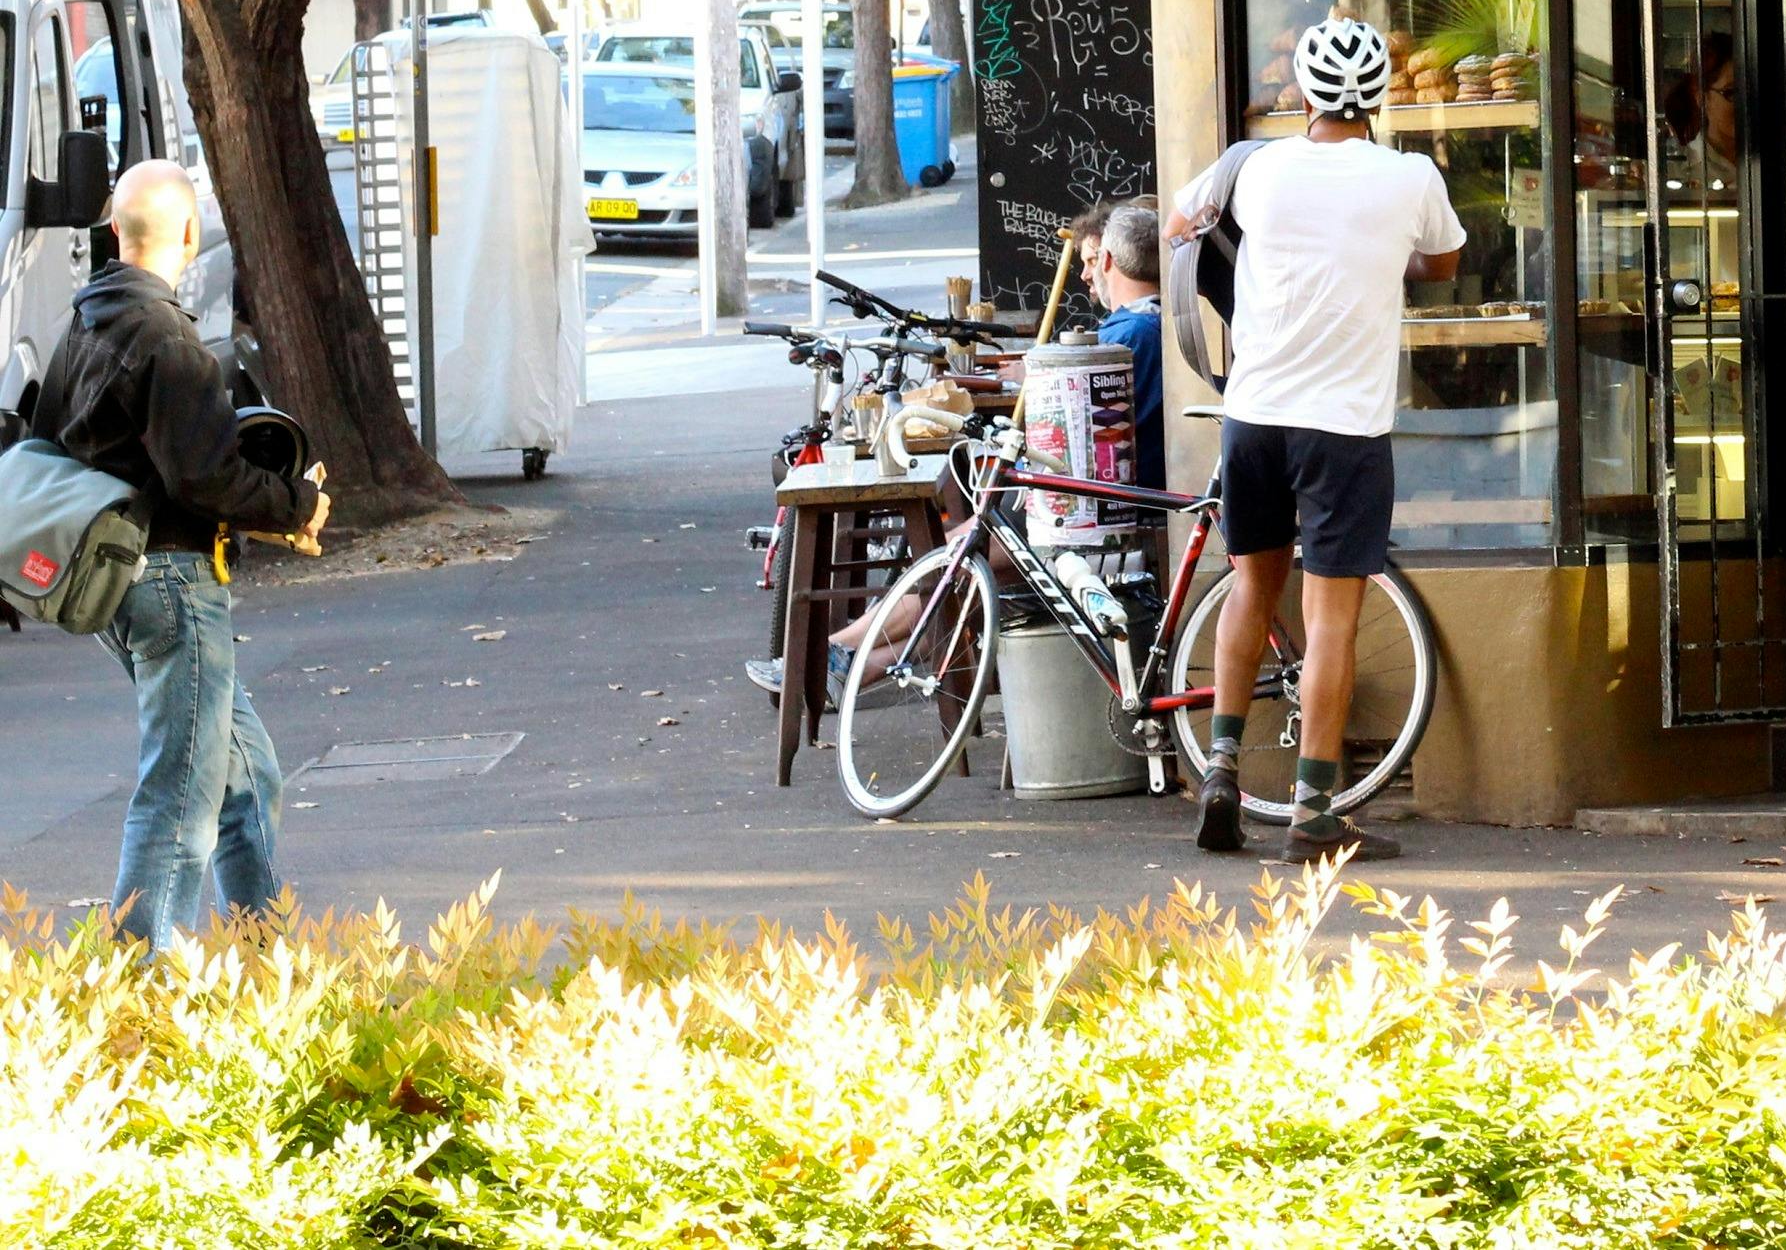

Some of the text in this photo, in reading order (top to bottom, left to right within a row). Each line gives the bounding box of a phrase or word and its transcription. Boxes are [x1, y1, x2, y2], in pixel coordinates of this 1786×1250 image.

[997, 200, 1024, 218] THE
[1093, 374, 1126, 389] Sibling
[992, 525, 1098, 642] SCOTT
